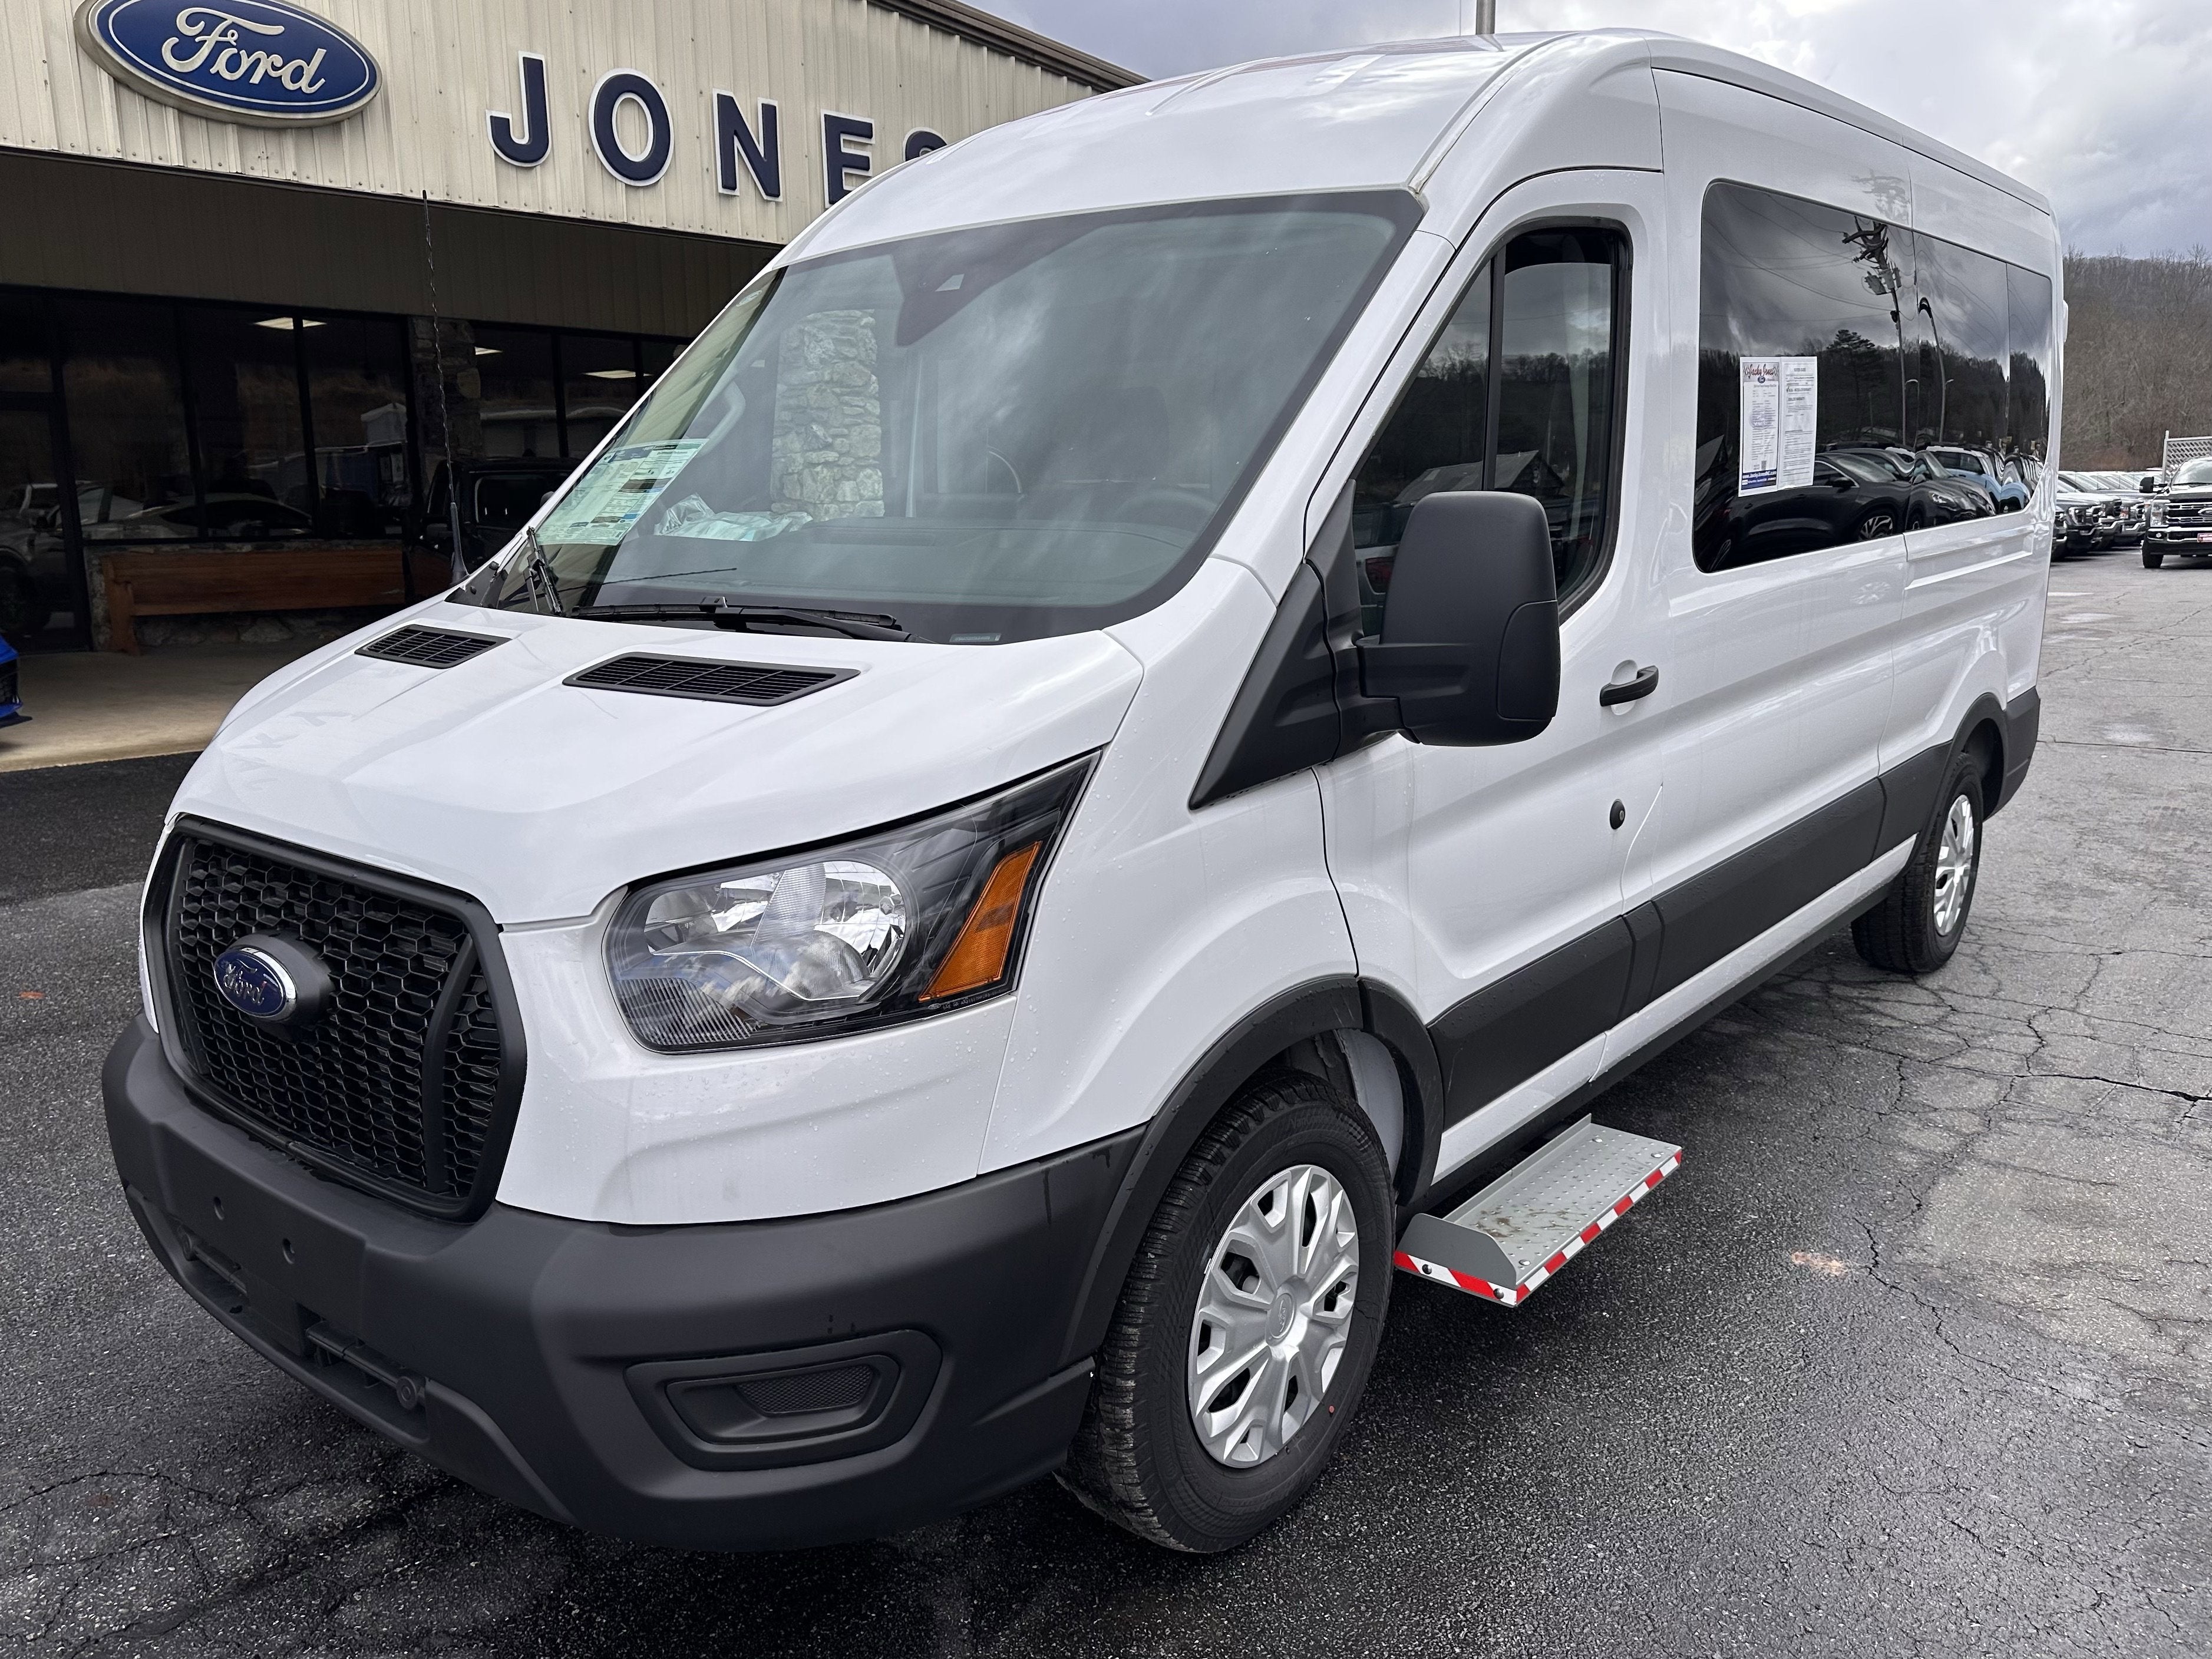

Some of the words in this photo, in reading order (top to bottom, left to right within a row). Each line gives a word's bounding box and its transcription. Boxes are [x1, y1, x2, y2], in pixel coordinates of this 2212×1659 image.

[161, 6, 326, 95] Ford
[486, 51, 948, 209] JONE
[223, 959, 267, 1005] Ford
